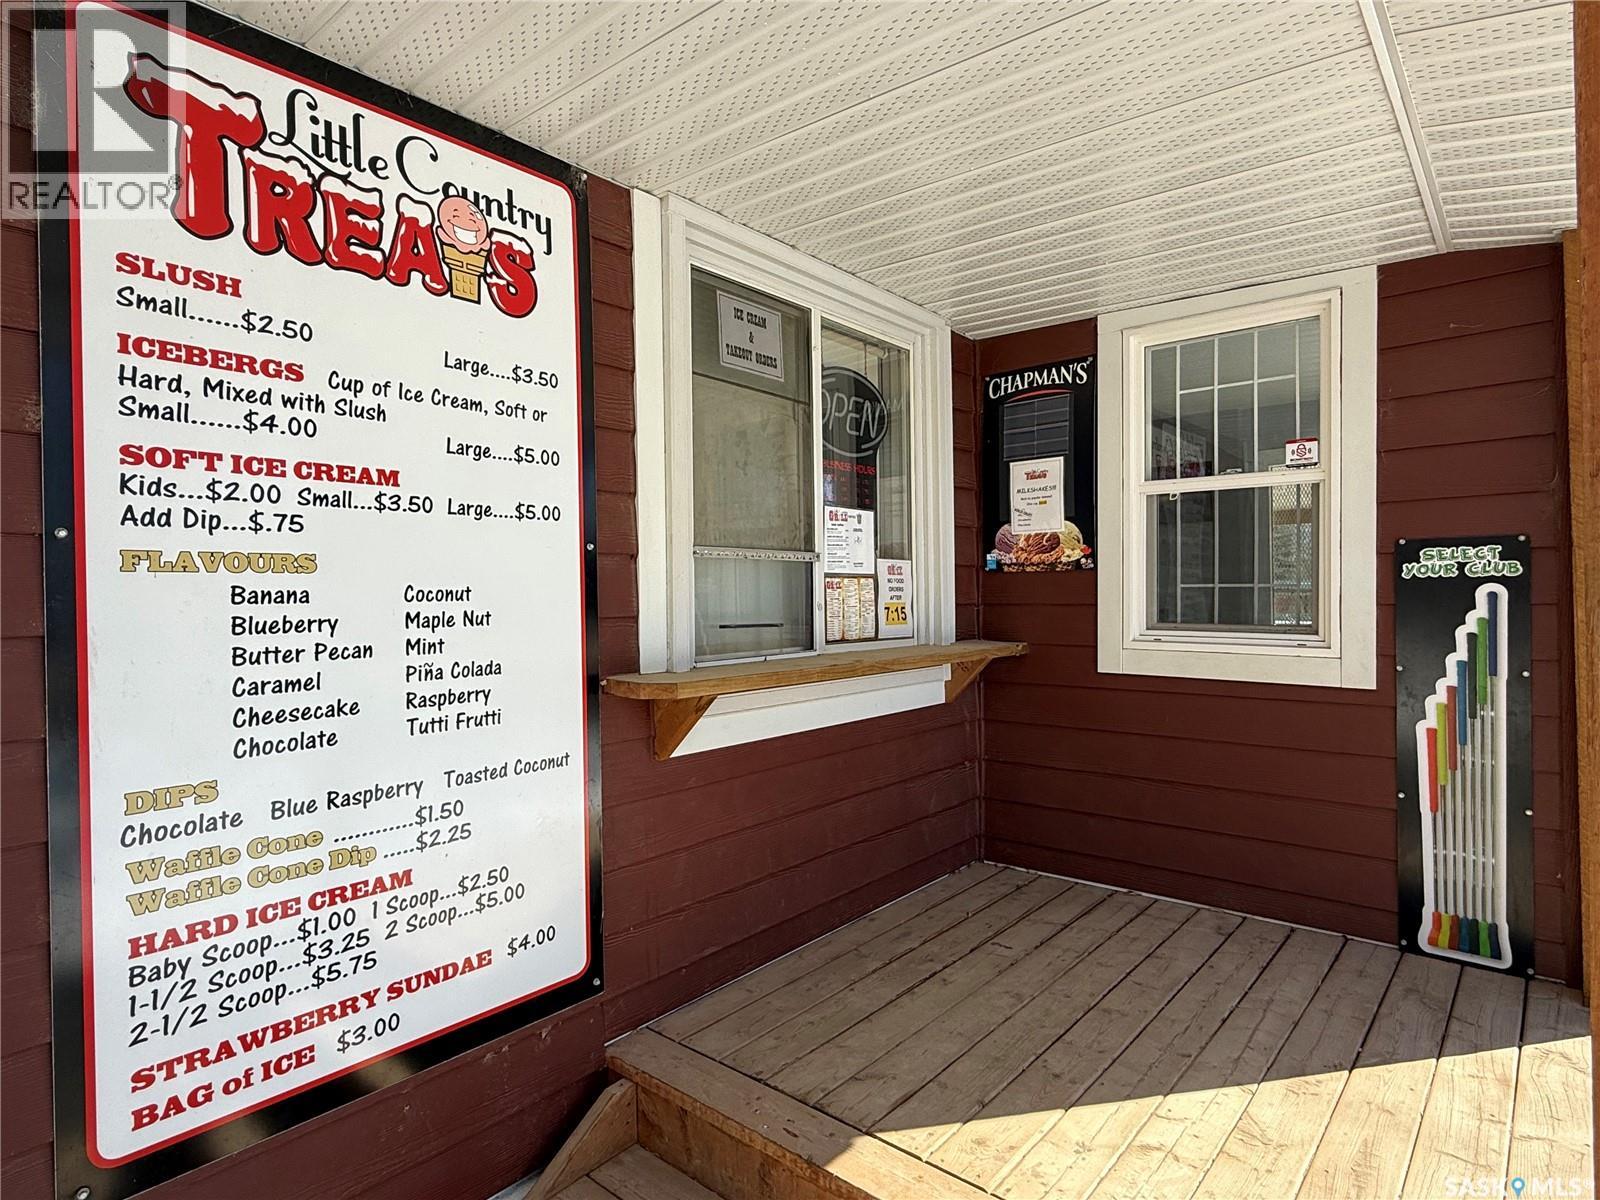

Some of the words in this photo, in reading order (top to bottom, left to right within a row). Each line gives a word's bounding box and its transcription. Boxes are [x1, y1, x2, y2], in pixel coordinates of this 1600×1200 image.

[268, 88, 390, 181] Little
[395, 135, 552, 255] Country
[115, 252, 242, 298] SLUSH
[733, 306, 744, 321] ICE
[746, 311, 767, 329] CREAM
[748, 331, 754, 344] &
[116, 332, 305, 382] ICEBERGS
[725, 343, 753, 362] TAKEOUT
[755, 351, 777, 369] ORDERS
[118, 363, 191, 397] Hard,
[203, 376, 272, 406] Mixed
[281, 392, 325, 414] with
[334, 398, 387, 422] Slush
[988, 362, 1088, 399] CHAPMAN'S
[328, 370, 364, 398] Cup
[372, 380, 391, 398] of
[398, 382, 424, 403] Ice
[431, 388, 489, 416] Cream,
[494, 400, 527, 419] Soft
[532, 408, 548, 422] or
[119, 443, 223, 472] SOFT
[230, 454, 286, 478] ICE
[293, 461, 400, 487] CREAM
[119, 504, 172, 528] Add
[119, 549, 319, 575] FLAVOURS
[1419, 545, 1502, 562] SELECT
[1402, 562, 1459, 579] YOUR
[1464, 560, 1523, 577] CLUB
[230, 585, 310, 605] Banana
[404, 584, 472, 603] Coconut
[231, 614, 339, 638] Blueberry
[405, 610, 456, 634] Maple
[463, 610, 492, 627] Nut
[884, 605, 907, 622] 7:15
[231, 646, 306, 667] Butter
[314, 642, 374, 661] Pecan
[405, 637, 445, 656] Mint
[232, 671, 321, 698] Caramel
[406, 662, 444, 683] Piña
[450, 660, 502, 679] Colada
[232, 698, 361, 728] Cheesecake
[406, 688, 492, 711] Raspberry
[406, 714, 449, 736] Tutti
[456, 708, 502, 730] Frutti
[233, 730, 338, 760] Chocolate
[120, 811, 244, 848] Chocolate
[271, 798, 319, 821] Blue
[326, 780, 424, 809] Raspberry
[444, 762, 508, 788] Toasted
[513, 752, 571, 775] Coconut
[124, 779, 219, 816] DIPS
[125, 845, 241, 884] Waffle
[246, 830, 324, 859] Cone
[126, 875, 241, 916] Waffle
[247, 858, 324, 888] Cone
[328, 845, 377, 870] Dip
[128, 914, 239, 960] HARD
[245, 896, 301, 929] ICE
[307, 868, 413, 911] CREAM
[128, 956, 192, 987] Baby
[371, 901, 378, 919] 1
[128, 978, 197, 1017] 1-1/2
[384, 920, 399, 940] 2
[131, 987, 382, 1093] STRAWBERRY
[386, 949, 493, 1002] SUNDAE
[506, 925, 556, 958] $4.00
[128, 1003, 208, 1048] 2-1/2
[131, 1082, 215, 1132] BAG
[221, 1068, 254, 1095] of
[261, 1044, 316, 1082] ICE
[336, 1012, 401, 1054] $3.00
